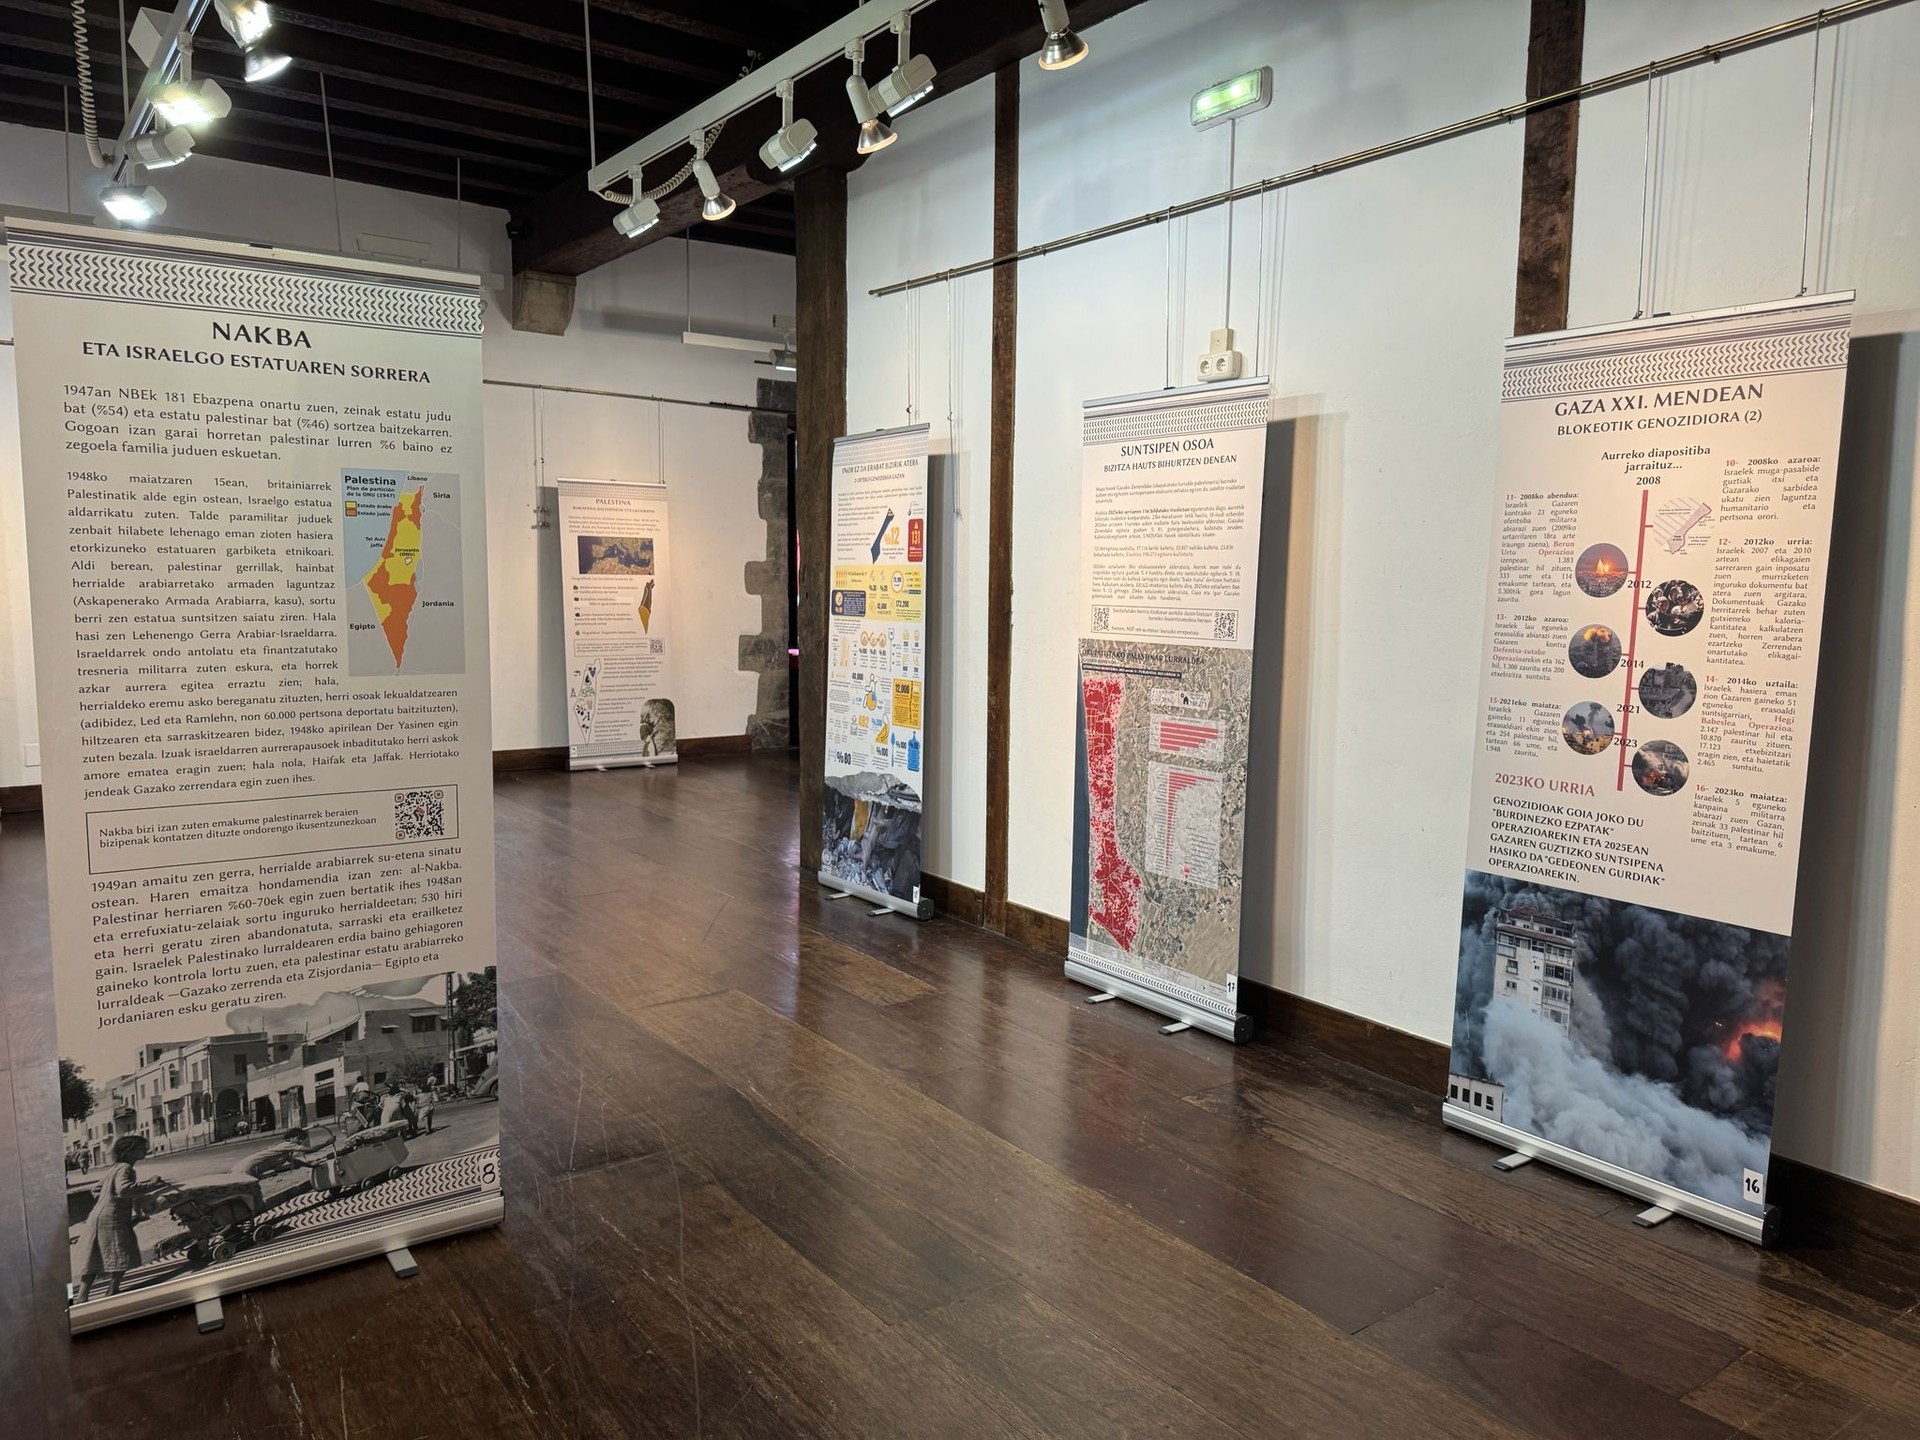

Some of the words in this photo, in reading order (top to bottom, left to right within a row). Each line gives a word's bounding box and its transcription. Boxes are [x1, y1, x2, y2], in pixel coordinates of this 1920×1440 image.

[213, 322, 311, 348] NAKBA
[83, 342, 120, 357] ETA
[127, 346, 224, 365] ISRAELGO
[231, 355, 344, 375] ESTATUAREN
[352, 365, 430, 383] SORRERA
[64, 384, 111, 398] 1947an
[119, 388, 157, 401] NBEk
[165, 392, 185, 403] 181
[194, 393, 254, 408] Ebazpena
[260, 400, 300, 411] onartu
[306, 404, 338, 415] zuen,
[344, 405, 381, 416] zeinak
[386, 409, 420, 420] estatu
[425, 410, 451, 423] judu
[1555, 399, 1605, 416] GAZA
[1612, 395, 1647, 411] XXI.
[1654, 384, 1763, 408] MENDEAN
[64, 401, 86, 414] bat
[92, 404, 128, 419] (%54)
[134, 408, 154, 418] eta
[160, 410, 200, 421] estatu
[206, 412, 268, 425] palestinar
[273, 415, 292, 427] bat
[297, 417, 329, 432] (%46)
[334, 422, 376, 433] sortzea
[380, 423, 451, 437] baitzekarren.
[1558, 420, 1633, 435] BLOKEOTIK
[1638, 412, 1740, 429] GENOZIDIORA
[1745, 409, 1762, 423] (2)
[65, 421, 118, 435] Gogoan
[128, 424, 156, 436] izan
[165, 428, 198, 440] garai
[207, 428, 261, 442] horretan
[270, 433, 330, 446] palestinar
[338, 436, 372, 448] lurren
[380, 440, 396, 450] %6
[402, 440, 434, 453] baino
[440, 446, 452, 454] ez
[1121, 442, 1179, 456] SUNTSIPEN
[1182, 438, 1214, 451] OSOA
[66, 440, 118, 454] zegoela
[122, 440, 168, 454] familia
[171, 444, 217, 458] juduen
[221, 447, 281, 460] eskuetan.
[1601, 449, 1645, 460] Aurreko
[1648, 445, 1710, 460] diapositiba
[1104, 463, 1131, 473] BIZITZA
[1132, 461, 1156, 470] HAUTS
[1158, 457, 1202, 468] BIHURTZEN
[1203, 455, 1237, 465] DENEAN
[1624, 460, 1682, 474] jarraituz...
[1724, 467, 1754, 476] Israelek
[1757, 464, 1820, 476] muga-pasabide
[1748, 457, 1779, 466] 2008ko
[67, 471, 108, 482] 1948ko
[129, 474, 192, 485] maiatzaren
[214, 477, 248, 488] 15ean,
[267, 479, 332, 491] britainiarrek
[1636, 476, 1661, 486] 2008
[67, 489, 137, 501] Palestinatik
[143, 491, 167, 502] alde
[172, 493, 197, 505] egin
[203, 495, 242, 505] ostean,
[248, 495, 289, 509] Israelgo
[294, 498, 332, 508] estatua
[596, 498, 631, 506] PALESTINA
[1787, 537, 1812, 545] urria:
[1627, 578, 1652, 590] 2012
[75, 631, 99, 641] hasi
[106, 633, 126, 641] zen
[132, 630, 194, 642] Lehenengo
[200, 630, 231, 639] Gerra
[236, 628, 337, 638] Arabiar-Israeldarra.
[1620, 658, 1644, 670] 2014
[1727, 677, 1757, 686] 2014ko
[1766, 680, 1798, 689] uztaila:
[1616, 703, 1640, 715] 2021
[1614, 737, 1638, 748] 2023
[1496, 773, 1544, 789] 2023KO
[1550, 780, 1594, 796] URRIA
[1714, 787, 1744, 797] 2023ko
[1750, 793, 1787, 803] maiatza:
[1494, 796, 1563, 814] GENOZIDIOAK
[1566, 808, 1593, 820] GOIA
[1594, 812, 1624, 824] JOKO
[1628, 817, 1644, 827] DU
[100, 826, 134, 837] Nakba
[136, 824, 154, 834] bizi
[158, 824, 178, 832] izan
[181, 822, 209, 830] zuten
[212, 818, 260, 828] emakume
[263, 811, 322, 825] palestinarrek
[325, 808, 358, 818] beraien
[100, 835, 150, 849] bizipenak
[153, 833, 203, 843] kontatzen
[206, 829, 240, 839] dituzte
[243, 825, 294, 836] ondorengo
[296, 817, 376, 830] ikusentzunezkoan
[1492, 821, 1580, 843] OPERAZIOAREKIN
[1583, 836, 1602, 848] ETA
[1605, 841, 1648, 855] 2025EAN
[1490, 845, 1527, 859] HASIKO
[1530, 852, 1543, 863] DA
[1491, 833, 1536, 848] GAZAREN
[1539, 842, 1592, 858] GUZTIZKO
[1595, 852, 1663, 872] SUNTSIPENA
[92, 880, 137, 892] 1949an
[142, 874, 188, 887] amaitu
[193, 873, 214, 882] zen
[219, 869, 254, 882] gerra,
[259, 860, 312, 875] herrialde
[316, 854, 374, 868] arabiarrek
[378, 851, 425, 863] su-etena
[428, 846, 461, 857] sinatu
[1489, 858, 1579, 882] OPERAZIOAREKIN.
[1227, 981, 1236, 993] 17
[98, 1009, 174, 1029] Jordaniaren
[178, 1002, 207, 1015] esku
[212, 998, 250, 1012] geratu
[254, 992, 286, 1003] ziren.
[482, 1163, 496, 1184] 8
[1745, 1177, 1760, 1194] 16
